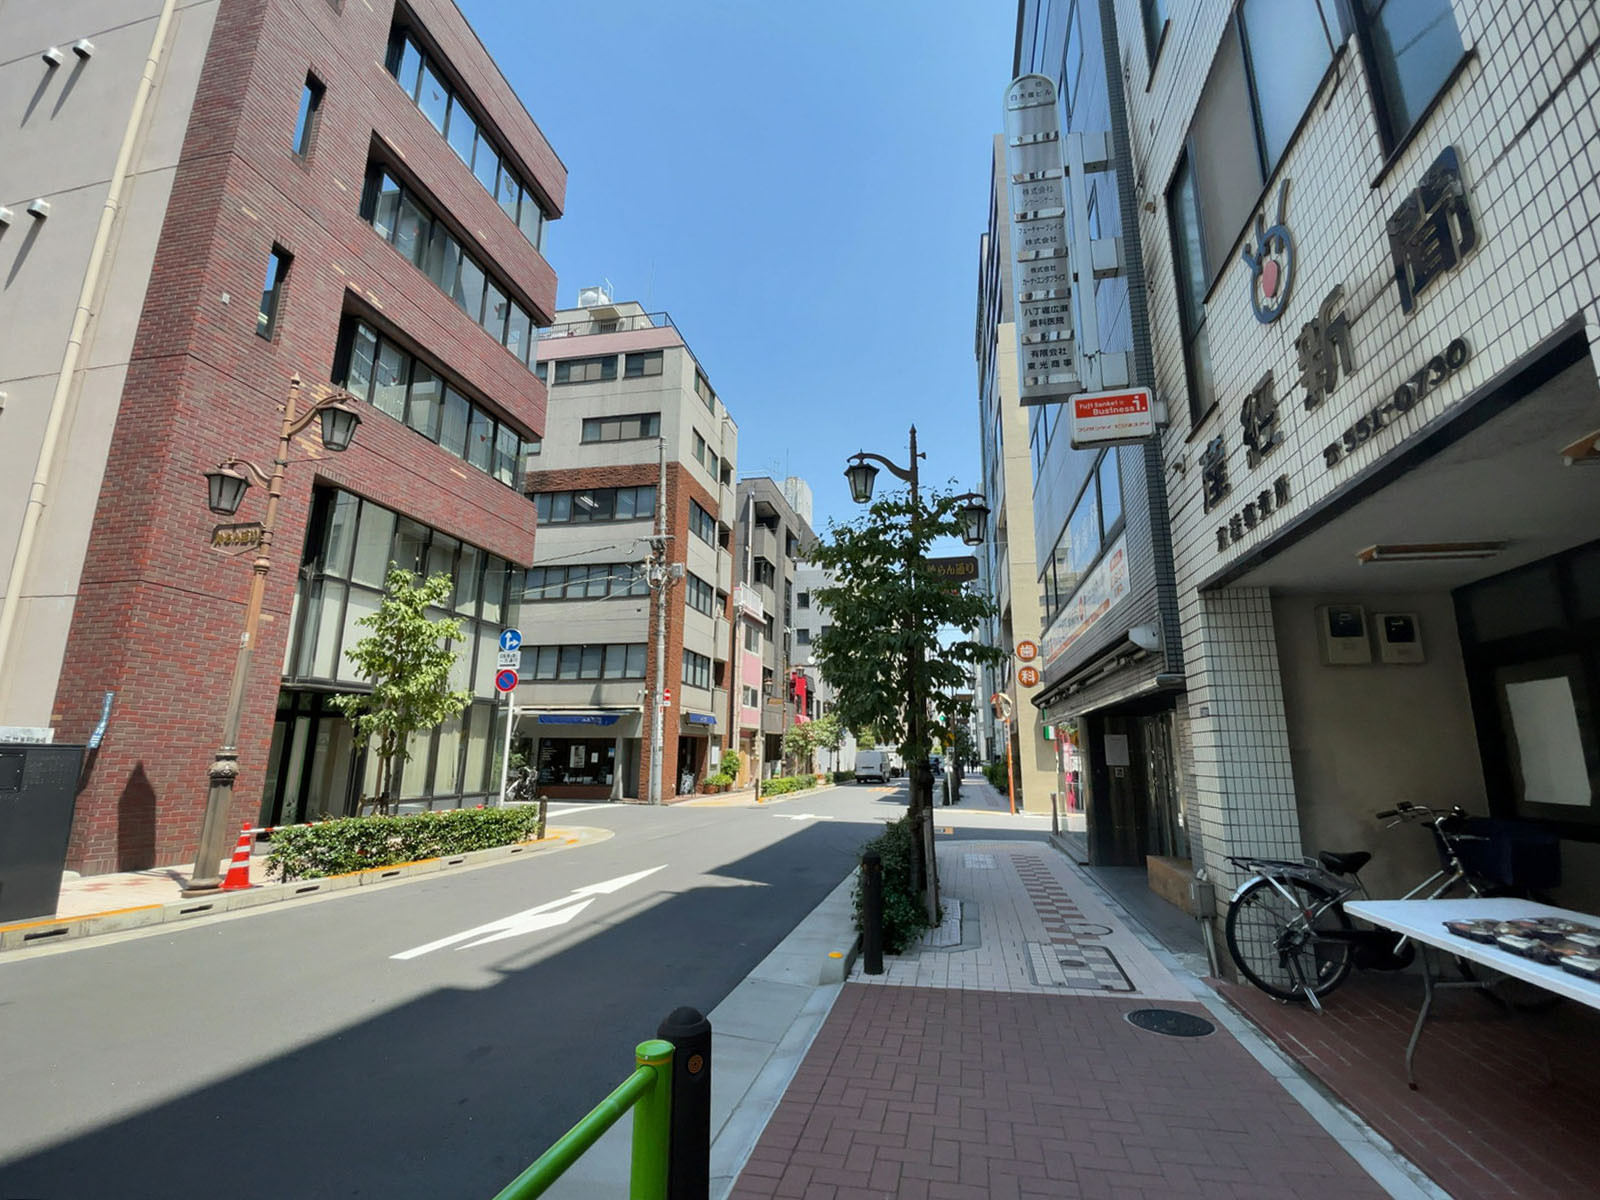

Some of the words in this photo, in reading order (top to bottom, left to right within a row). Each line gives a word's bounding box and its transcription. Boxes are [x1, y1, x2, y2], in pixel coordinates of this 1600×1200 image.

[1023, 185, 1053, 196] 株式会社
[1025, 235, 1057, 246] 株式会社
[1030, 265, 1056, 274] 株式会社
[1029, 316, 1065, 328] 歯科医院
[1030, 347, 1067, 359] 有限会社
[1027, 358, 1072, 371] 東光商事
[1093, 405, 1135, 416] Business
